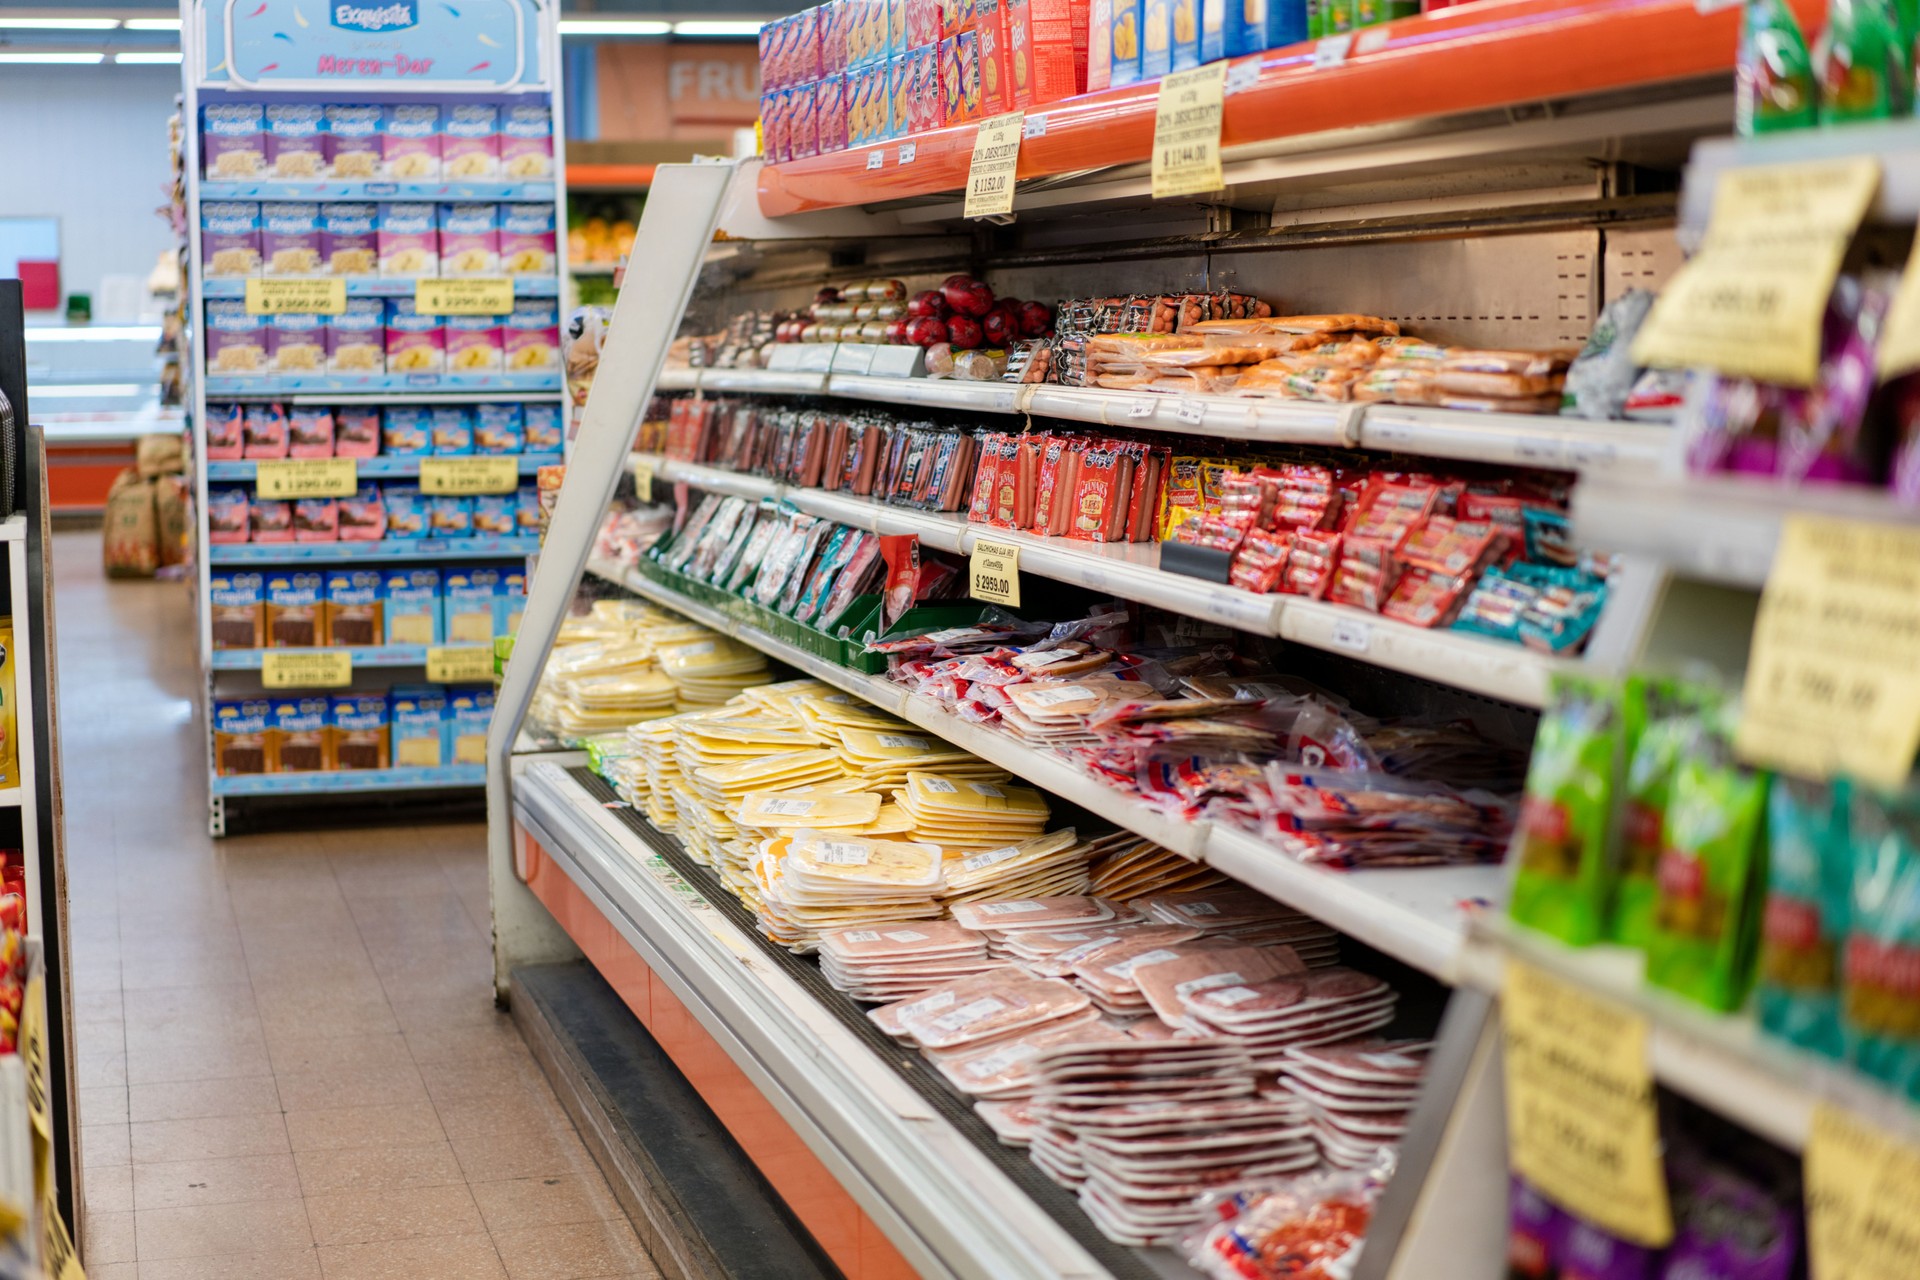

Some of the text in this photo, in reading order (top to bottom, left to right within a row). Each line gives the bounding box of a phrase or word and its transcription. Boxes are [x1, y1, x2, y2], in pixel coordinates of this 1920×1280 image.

[335, 2, 413, 31] Exquisita
[981, 29, 996, 58] Rex
[1011, 21, 1027, 51] Rex
[317, 53, 434, 77] Meren-Dar
[974, 176, 1006, 194] $ 1152.00
[976, 574, 1009, 593] $ 2959.00
